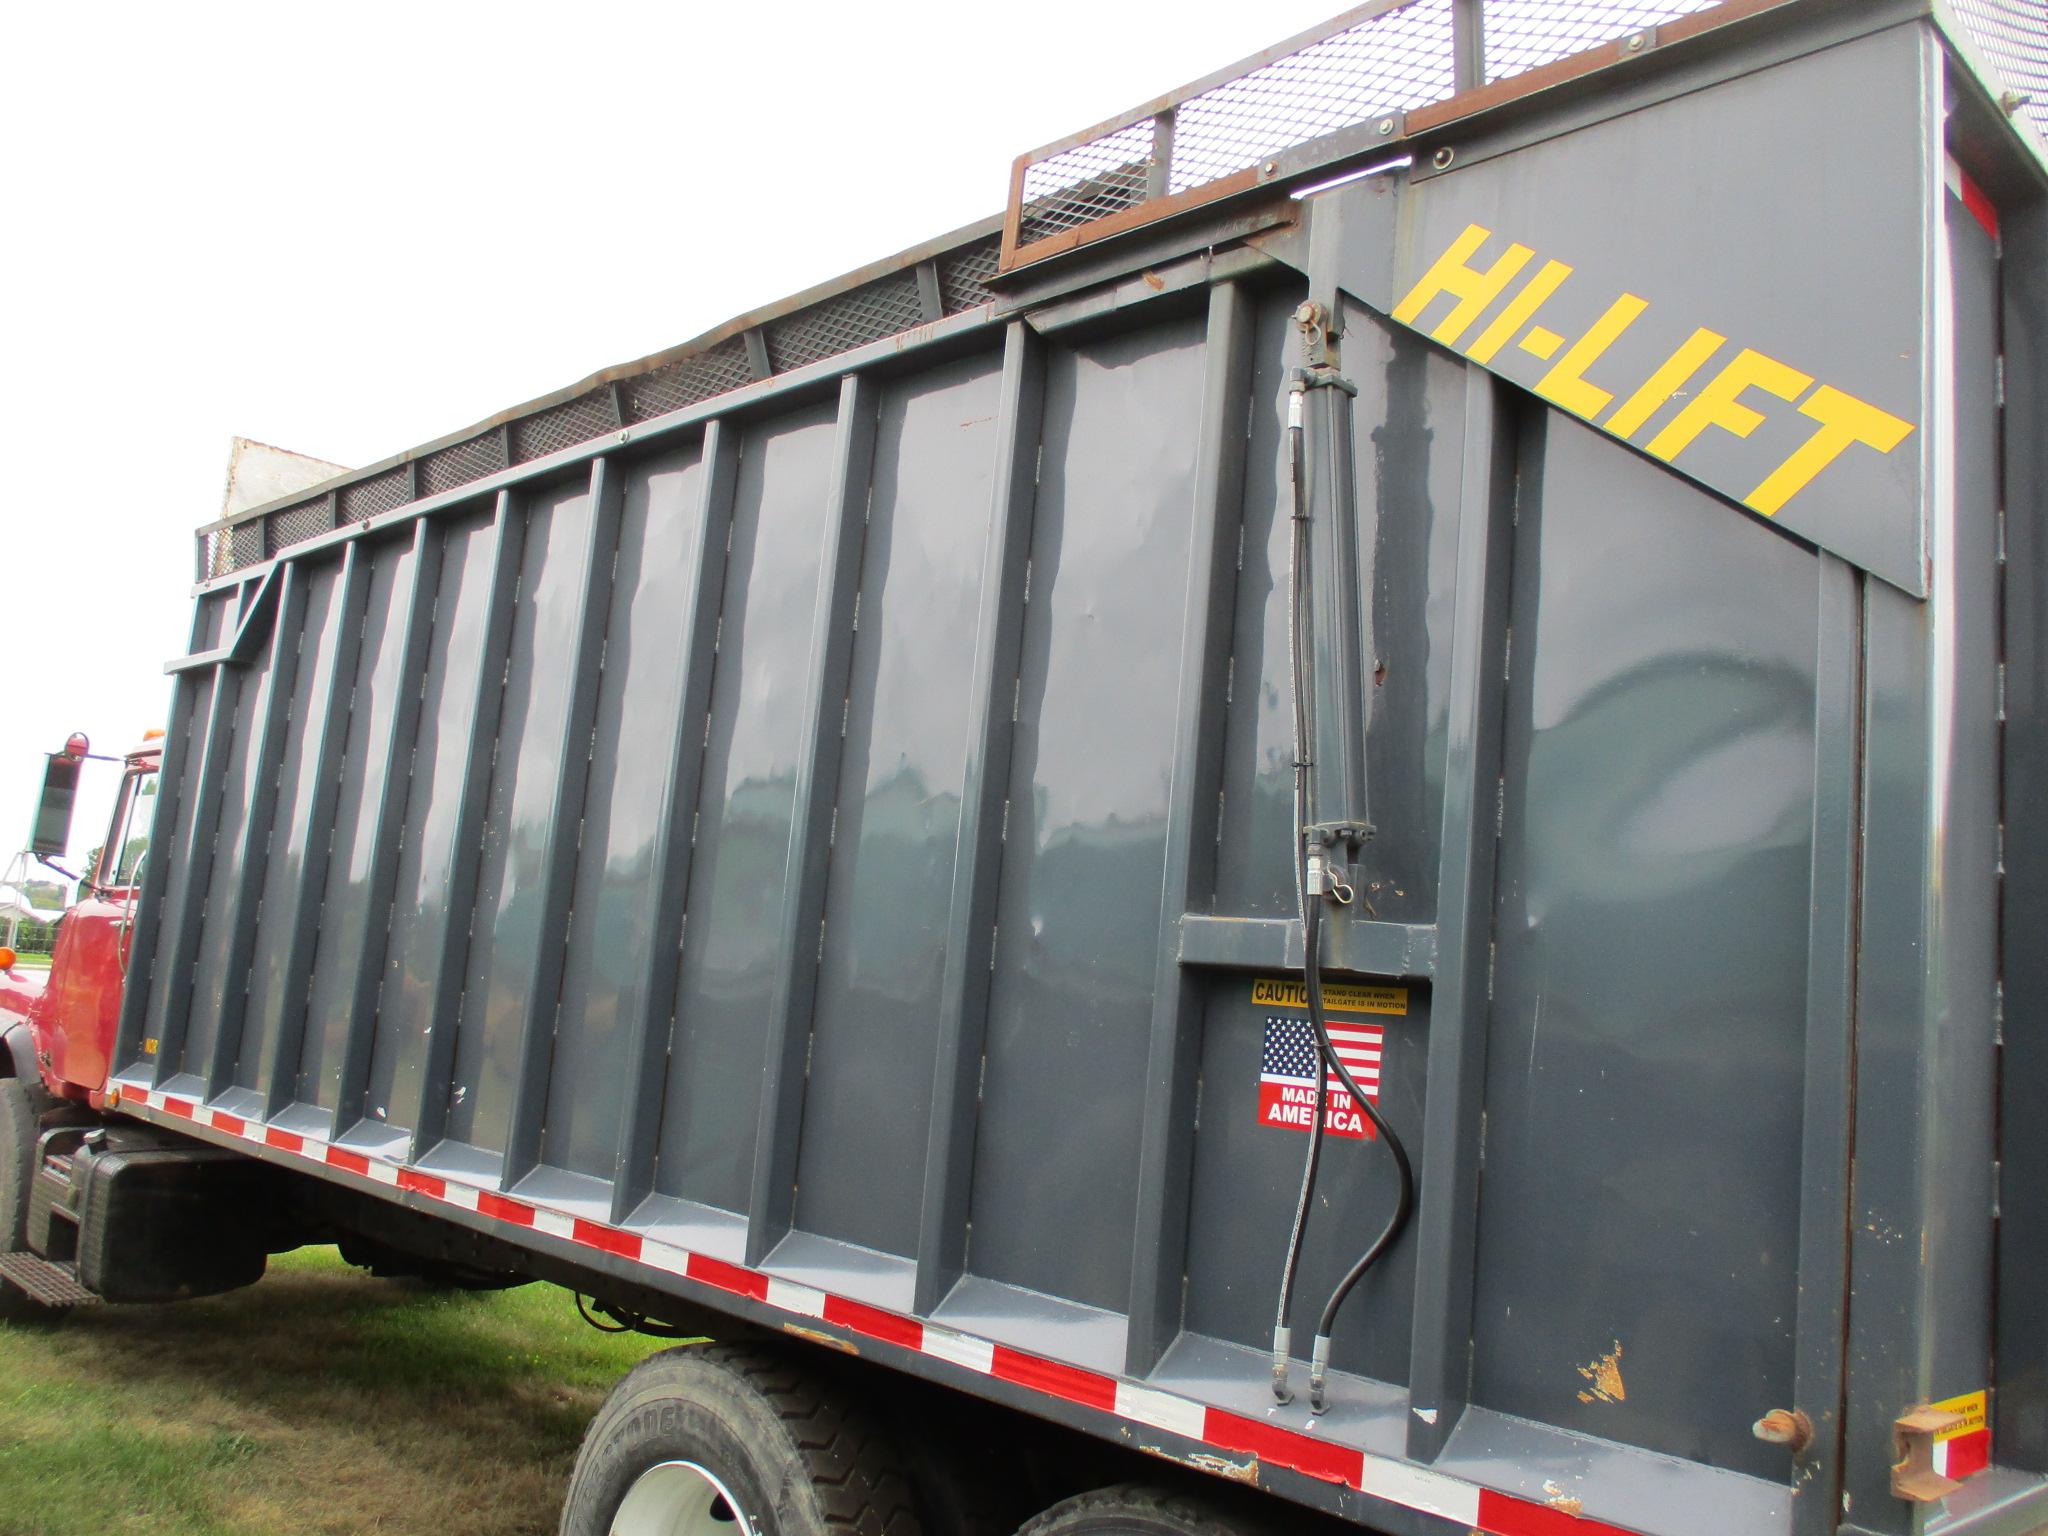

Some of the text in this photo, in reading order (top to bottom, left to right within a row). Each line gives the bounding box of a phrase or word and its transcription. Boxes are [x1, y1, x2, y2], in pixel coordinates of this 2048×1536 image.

[1391, 223, 1915, 517] HI-LIFT
[1255, 983, 1309, 1004] CAUTIO
[1323, 989, 1347, 997] STAND
[1348, 990, 1371, 998] CLEAR
[1323, 998, 1356, 1007] TAILGATE
[1376, 1002, 1406, 1010] MOTION
[1281, 1087, 1351, 1109] MAD IN
[1268, 1103, 1363, 1132] AMEICA
